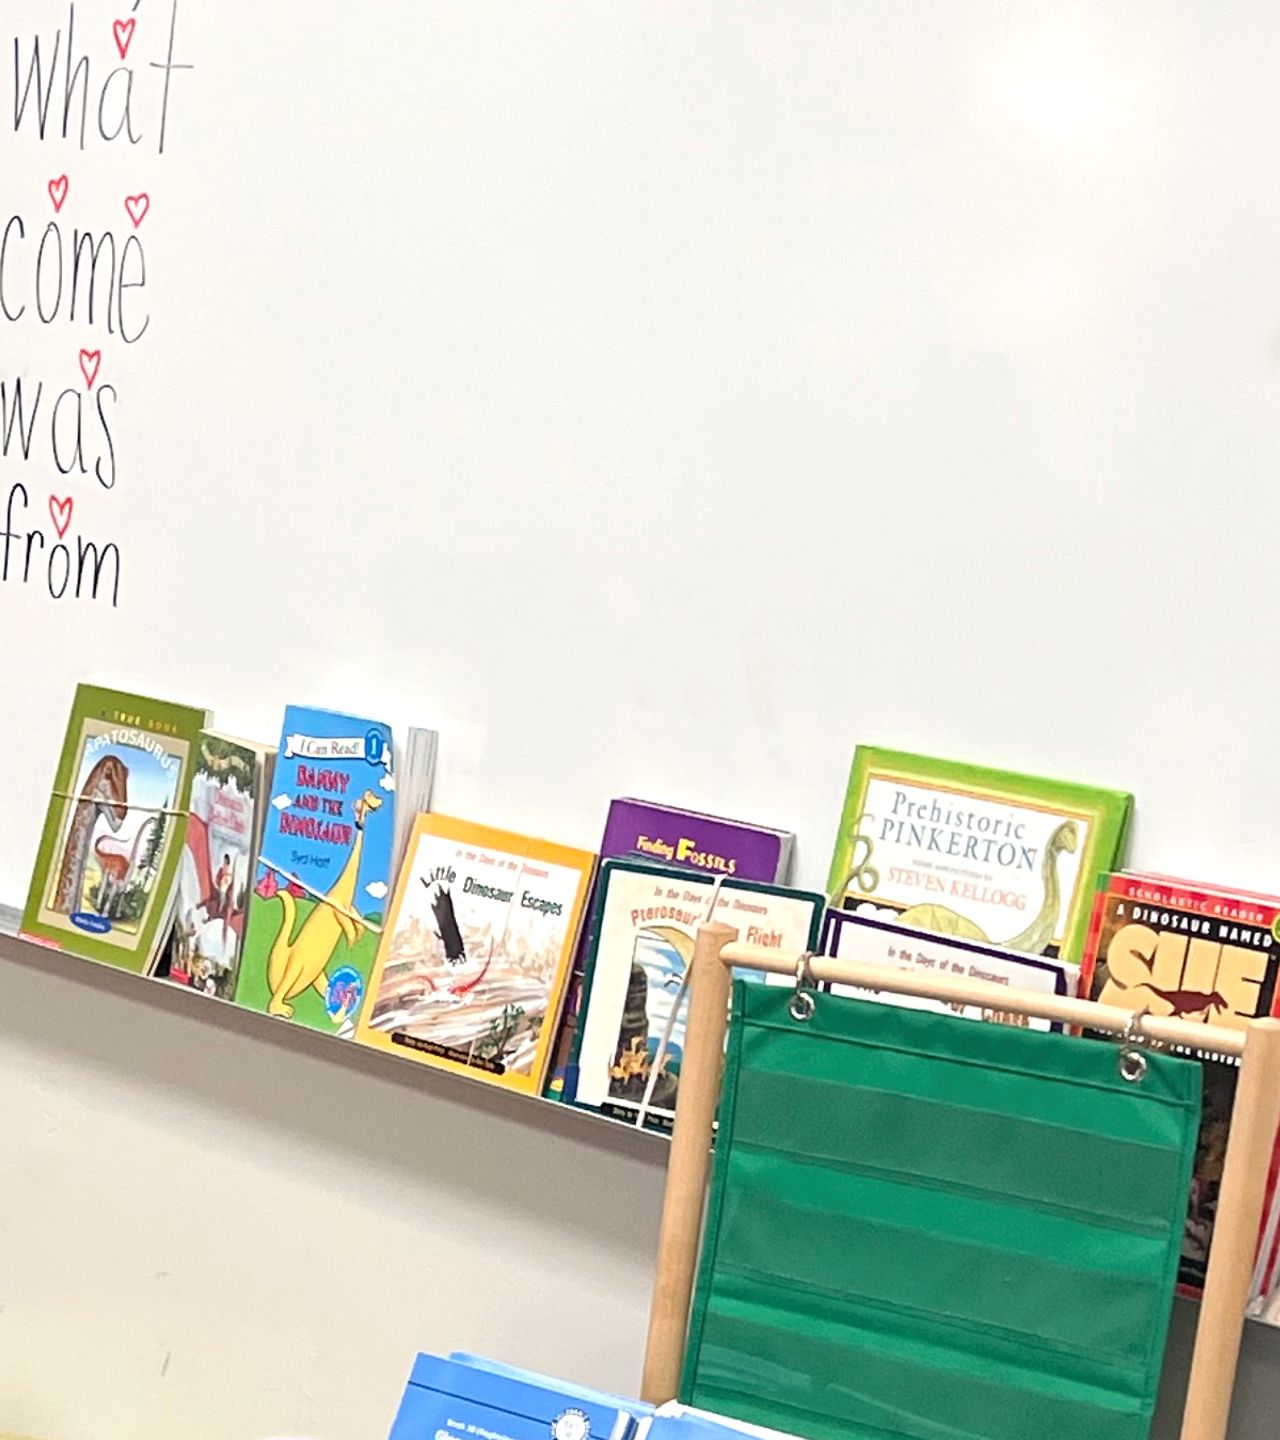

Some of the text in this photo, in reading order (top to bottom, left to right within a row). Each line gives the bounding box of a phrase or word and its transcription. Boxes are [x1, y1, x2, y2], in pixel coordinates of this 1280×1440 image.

[0, 216, 151, 343] come
[0, 377, 118, 489] was
[86, 729, 178, 778] APATOSAURUS
[296, 764, 351, 795] DANNY
[292, 794, 344, 818] AND THE
[891, 791, 1027, 841] Prehistoric
[279, 813, 352, 847] DINOSAUR
[636, 835, 675, 861] Finding
[879, 816, 1039, 872] PINKERTON
[420, 864, 564, 917] Little Dinosaur Escapes
[887, 866, 947, 893] STEVEN
[950, 879, 1028, 911] KELLOGG
[1128, 886, 1265, 922] SCHOLASTIC READER
[630, 905, 784, 949] Pterosaur' Flight
[1116, 903, 1274, 948] A DINOSAUR NAMED
[916, 952, 936, 968] Days
[939, 959, 950, 970] of
[1097, 923, 1270, 1025] SUE
